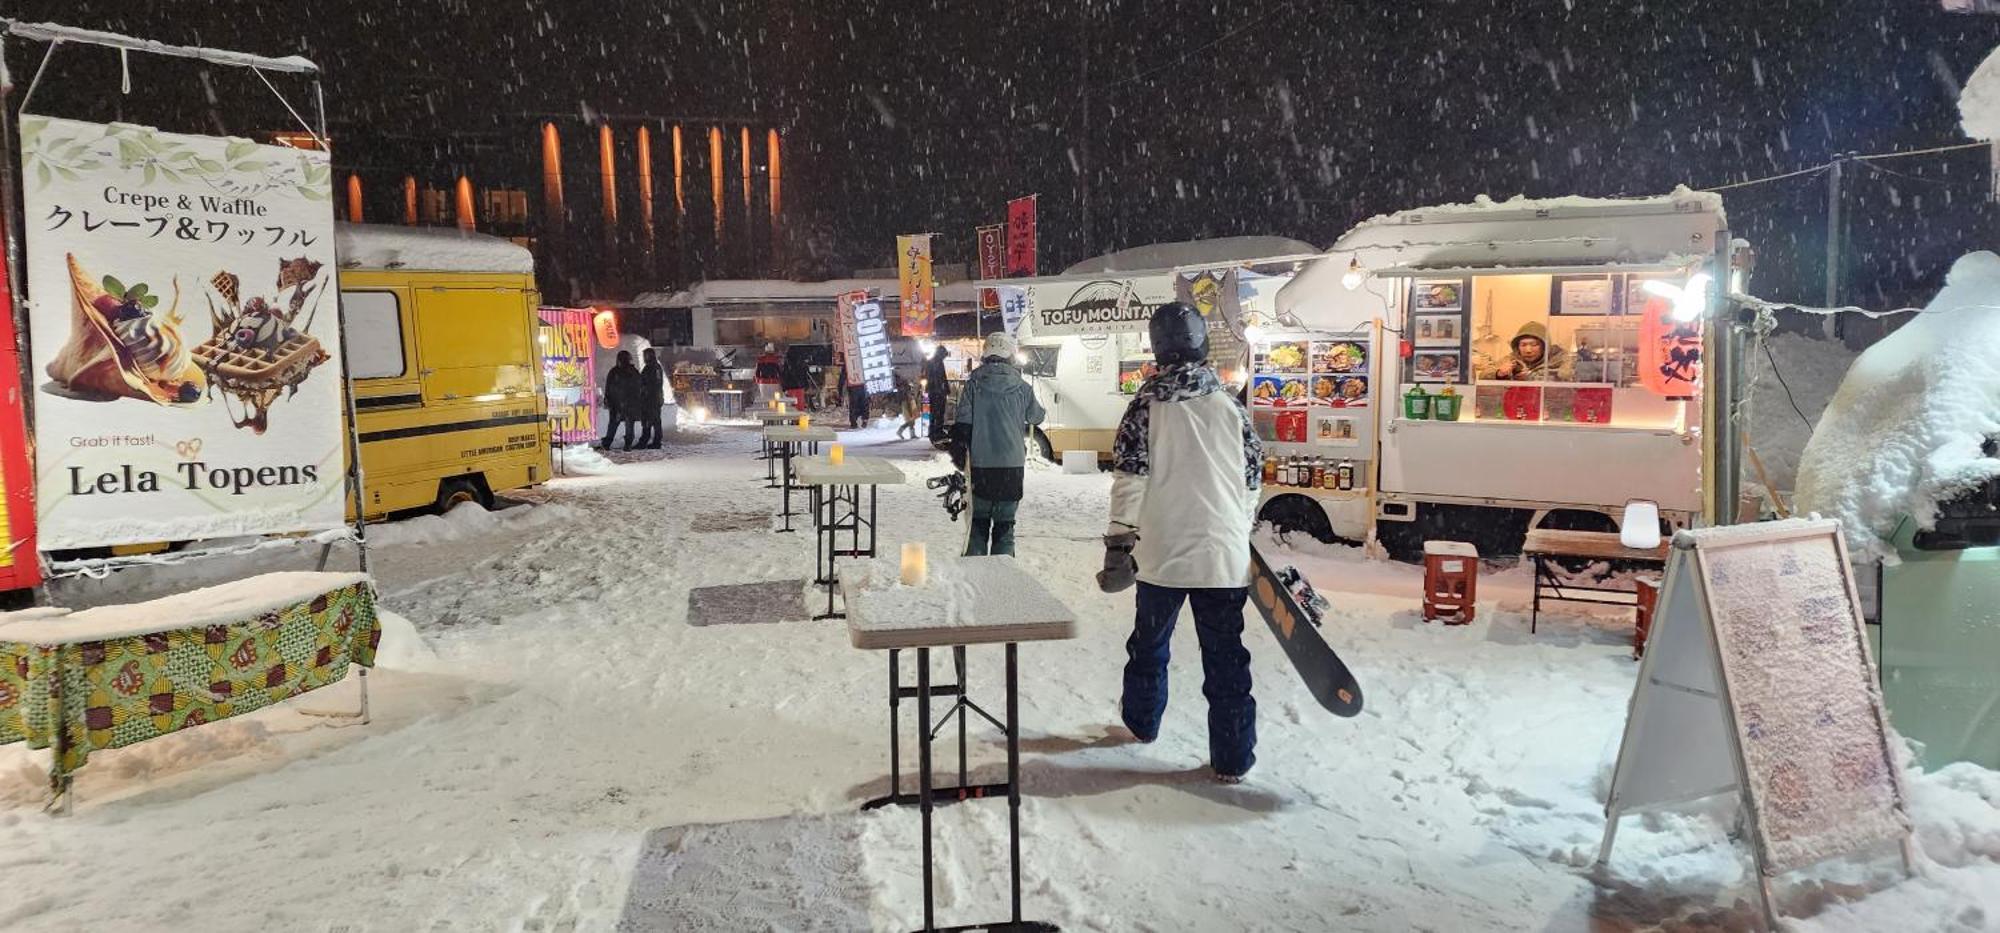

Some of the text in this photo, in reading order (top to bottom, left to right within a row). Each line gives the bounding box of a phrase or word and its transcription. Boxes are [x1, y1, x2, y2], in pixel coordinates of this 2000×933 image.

[103, 186, 267, 217] Crepe & Waffle
[47, 204, 318, 248] クレープ&ワッフル
[1042, 304, 1158, 326] TOFU MOUNTAI
[70, 435, 155, 448] Grab it fast!
[67, 461, 319, 496] Lela Topens
